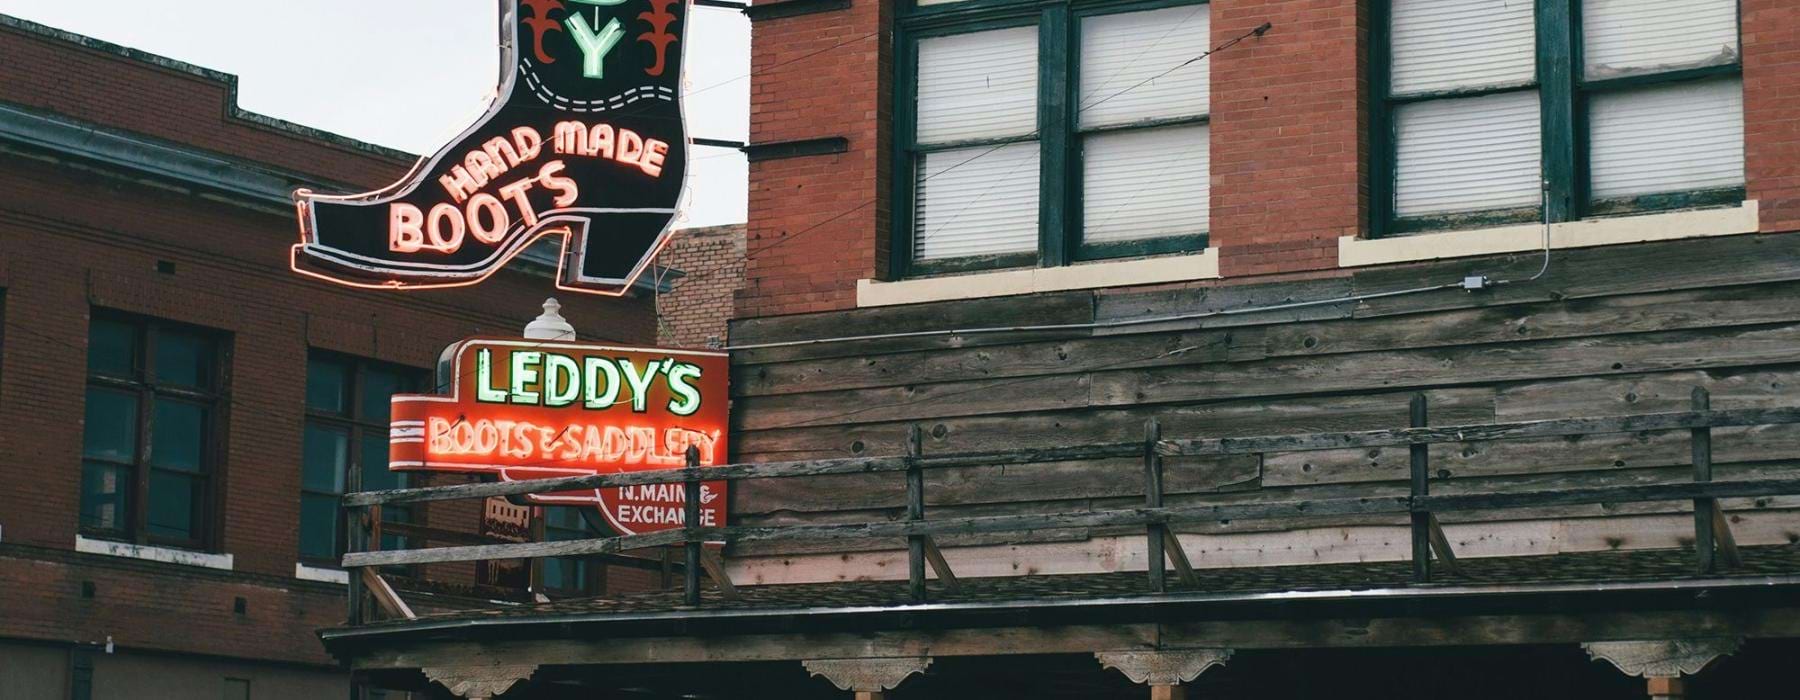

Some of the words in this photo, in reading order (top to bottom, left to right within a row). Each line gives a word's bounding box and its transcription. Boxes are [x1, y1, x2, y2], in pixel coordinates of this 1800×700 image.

[564, 11, 626, 79] Y
[439, 126, 542, 204] HAND
[553, 120, 669, 178] MADE
[389, 160, 578, 253] BOOTS
[476, 348, 702, 415] LEDDY'S
[427, 415, 535, 461] BOOTS
[699, 484, 718, 504] &
